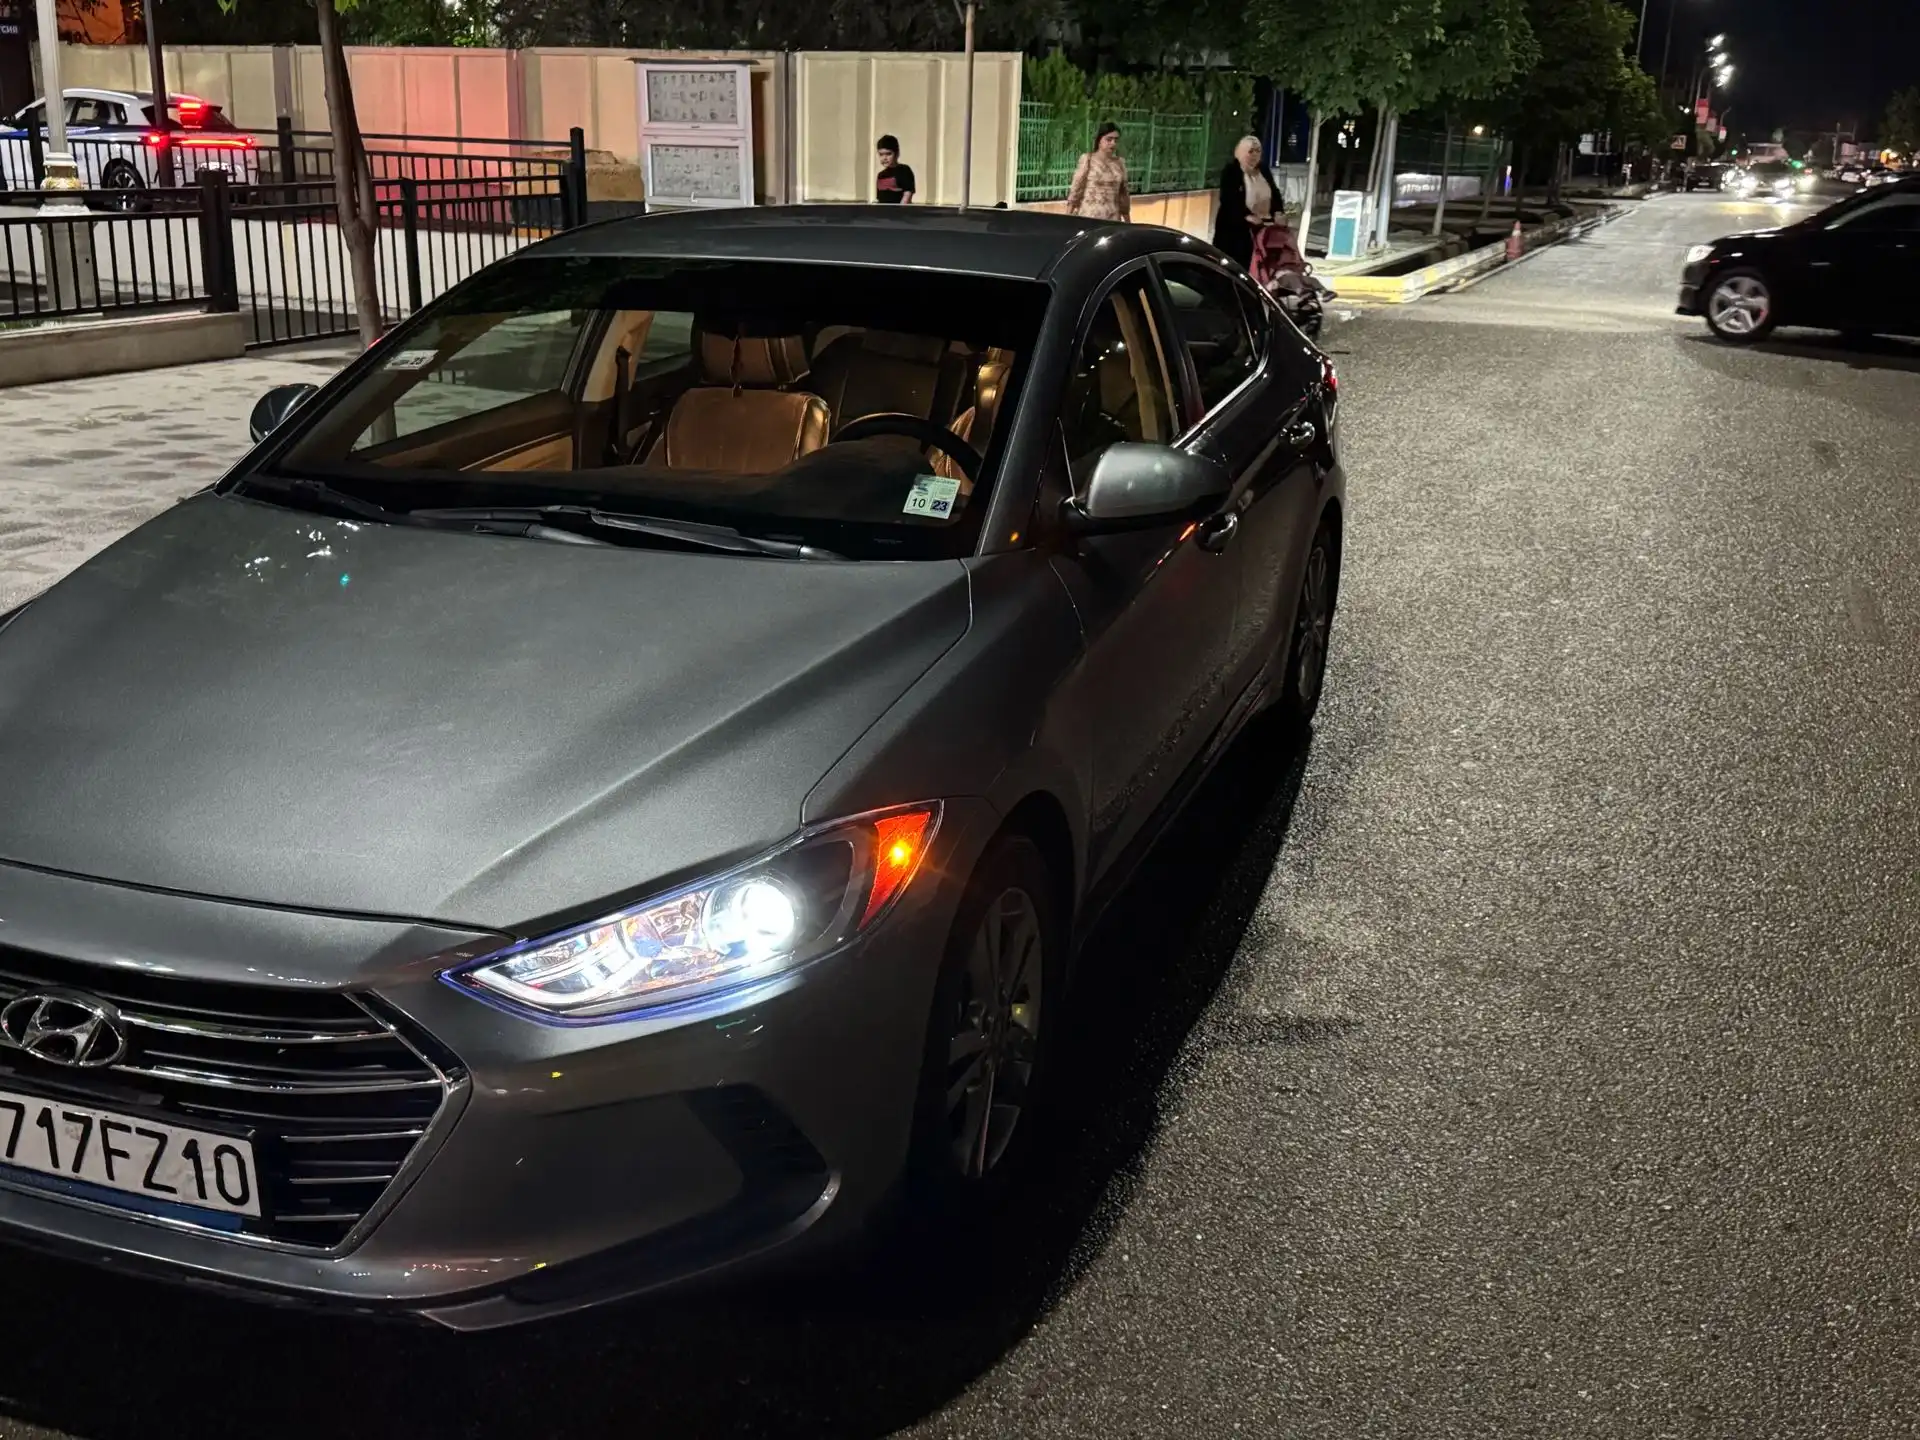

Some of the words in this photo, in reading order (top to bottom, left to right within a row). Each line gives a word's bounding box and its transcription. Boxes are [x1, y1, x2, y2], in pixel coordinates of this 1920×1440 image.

[912, 498, 926, 508] 10
[931, 500, 948, 511] 23
[0, 1100, 250, 1206] 717FZ10
